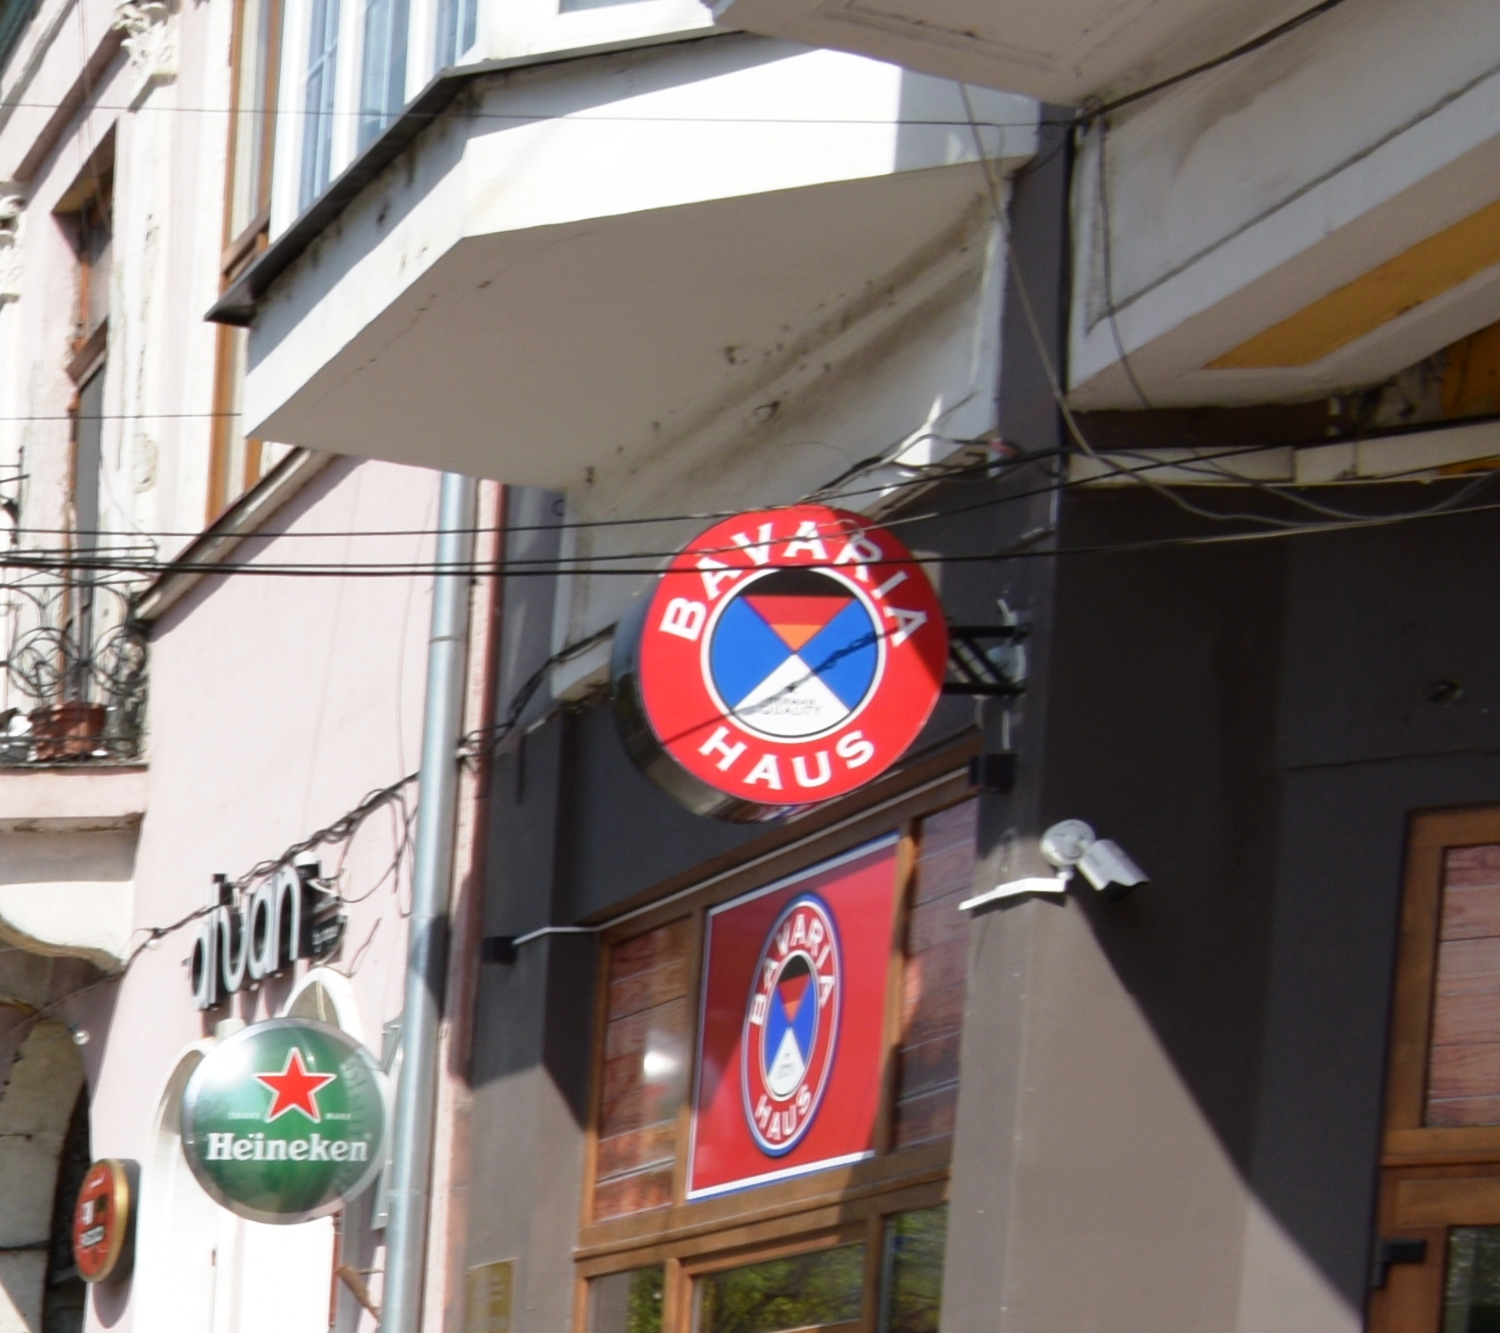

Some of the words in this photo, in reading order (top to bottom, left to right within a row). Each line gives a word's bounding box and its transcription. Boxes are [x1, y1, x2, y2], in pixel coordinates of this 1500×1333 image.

[659, 521, 927, 648] BAVARIA
[698, 726, 875, 790] HAUS
[750, 914, 835, 1026] BAVARIA
[754, 1084, 812, 1141] HAUS
[205, 1131, 368, 1162] Heineken
